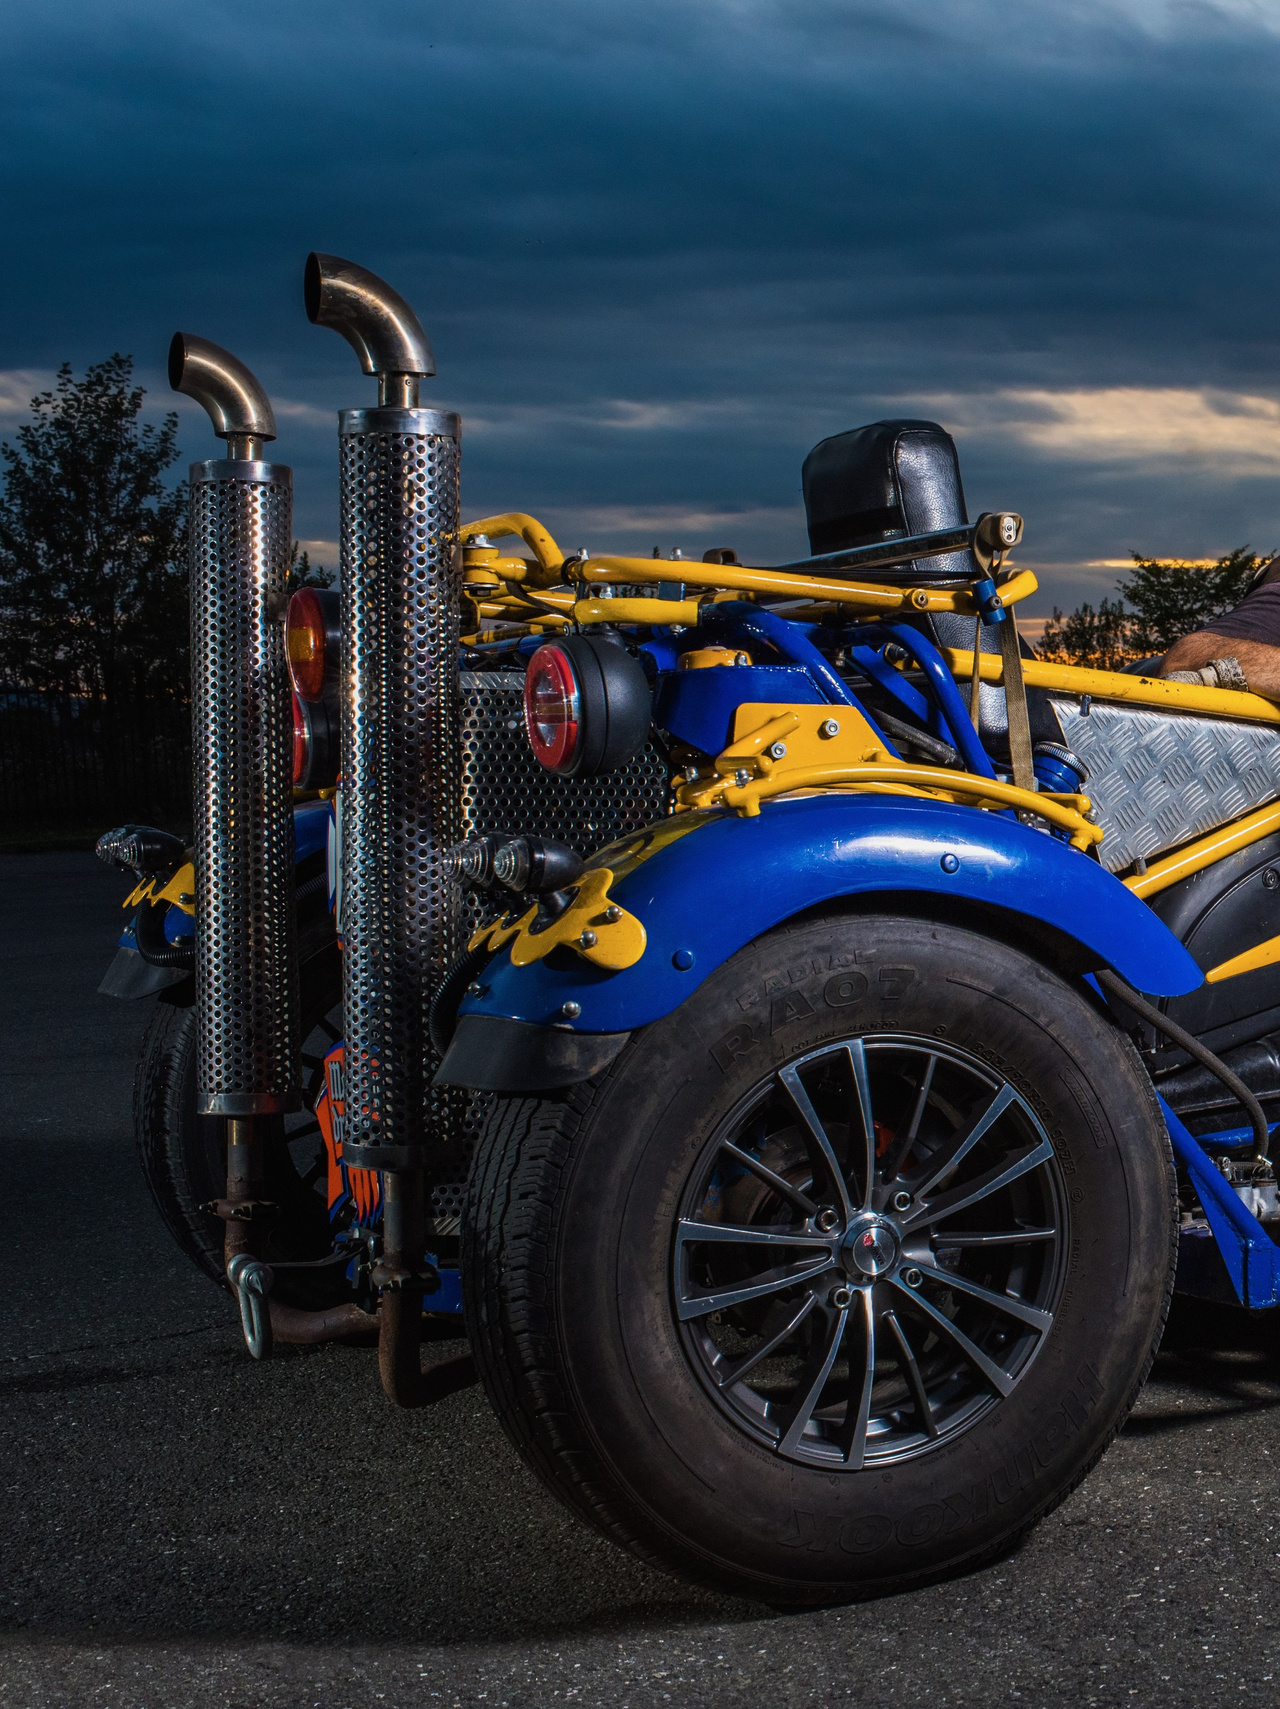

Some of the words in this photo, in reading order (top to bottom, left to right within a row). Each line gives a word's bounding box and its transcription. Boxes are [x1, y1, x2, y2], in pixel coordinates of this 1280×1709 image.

[735, 949, 878, 1012] RADIAL
[973, 1041, 1053, 1122] 245/70R16
[1051, 1129, 1077, 1176] 107H
[1069, 1238, 1081, 1275] RADIAL
[1051, 1289, 1073, 1340] TUBELESS
